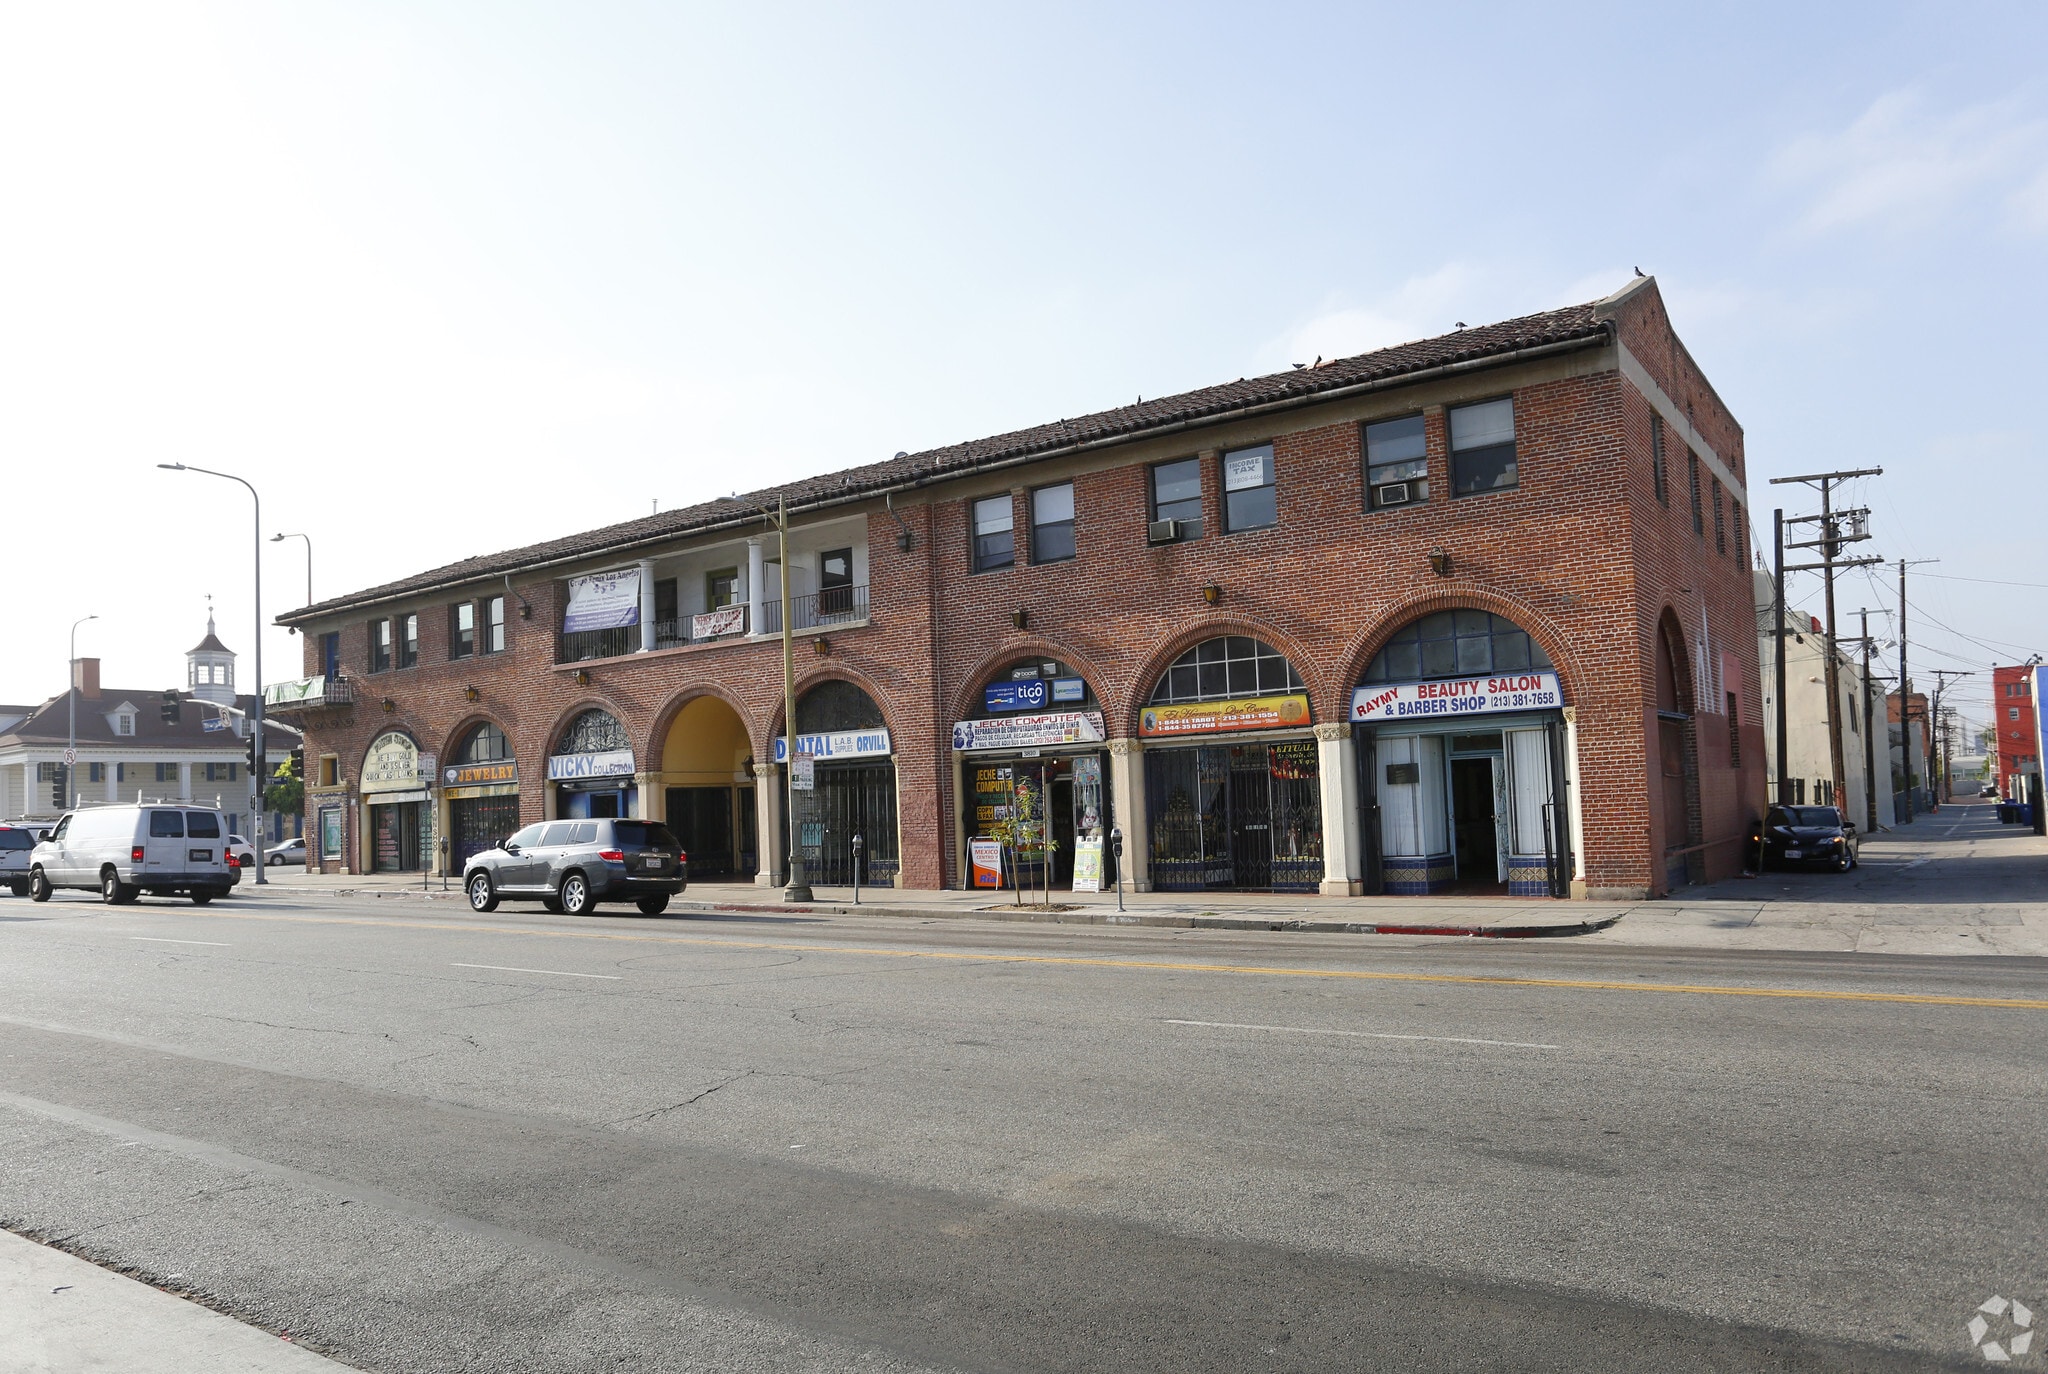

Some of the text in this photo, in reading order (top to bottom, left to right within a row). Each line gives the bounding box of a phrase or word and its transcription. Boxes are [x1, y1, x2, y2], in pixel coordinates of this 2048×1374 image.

[1229, 458, 1260, 469] INCOME
[1233, 465, 1255, 474] TAX
[606, 573, 616, 581] Los
[617, 569, 640, 580] Angeles
[1018, 683, 1042, 698] tigo
[1417, 675, 1541, 699] BEAUTY SALON
[1356, 687, 1399, 717] RAYMY
[1384, 691, 1555, 716] & BARBER SHOP (213) 381-7658
[1164, 703, 1270, 720] El Hermano Que Cura
[975, 718, 1012, 728] JECKE
[1158, 717, 1190, 726] 1-844-EL
[1223, 712, 1278, 721] 213-381-1554
[975, 727, 1000, 735] REPARACION
[1001, 726, 1007, 734] DE
[1007, 723, 1042, 733] COMPUTADORAS
[1060, 721, 1065, 729] DE
[776, 736, 833, 759] DNTAL
[857, 735, 885, 752] ORVILL
[834, 744, 853, 753] SUPPLIES
[398, 751, 412, 760] GOLD
[550, 755, 632, 777] VICKY COLLECTION
[458, 765, 514, 782] JEWELRY
[980, 872, 997, 882] Ria
